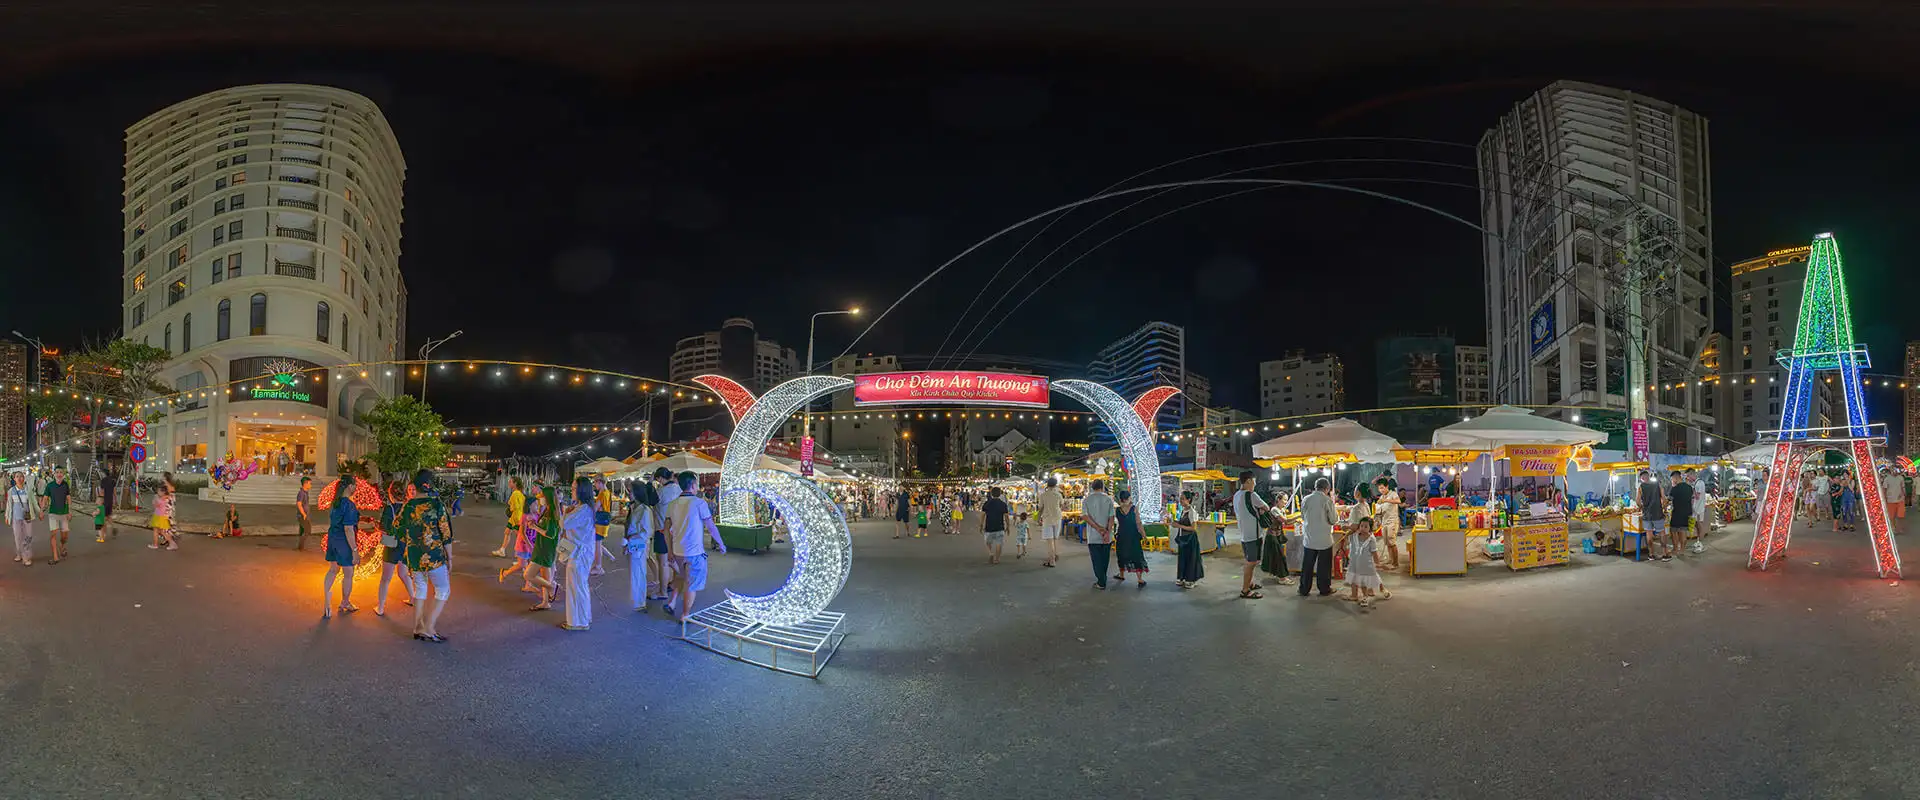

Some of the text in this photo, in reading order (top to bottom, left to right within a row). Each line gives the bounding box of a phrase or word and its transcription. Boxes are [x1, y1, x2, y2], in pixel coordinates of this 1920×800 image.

[1768, 248, 1794, 256] GOLDEN
[875, 376, 907, 392] Chợ
[909, 375, 945, 389] Đêm
[949, 375, 972, 389] An
[976, 375, 1031, 394] Thượng
[251, 388, 310, 401] Tamarind Hotel
